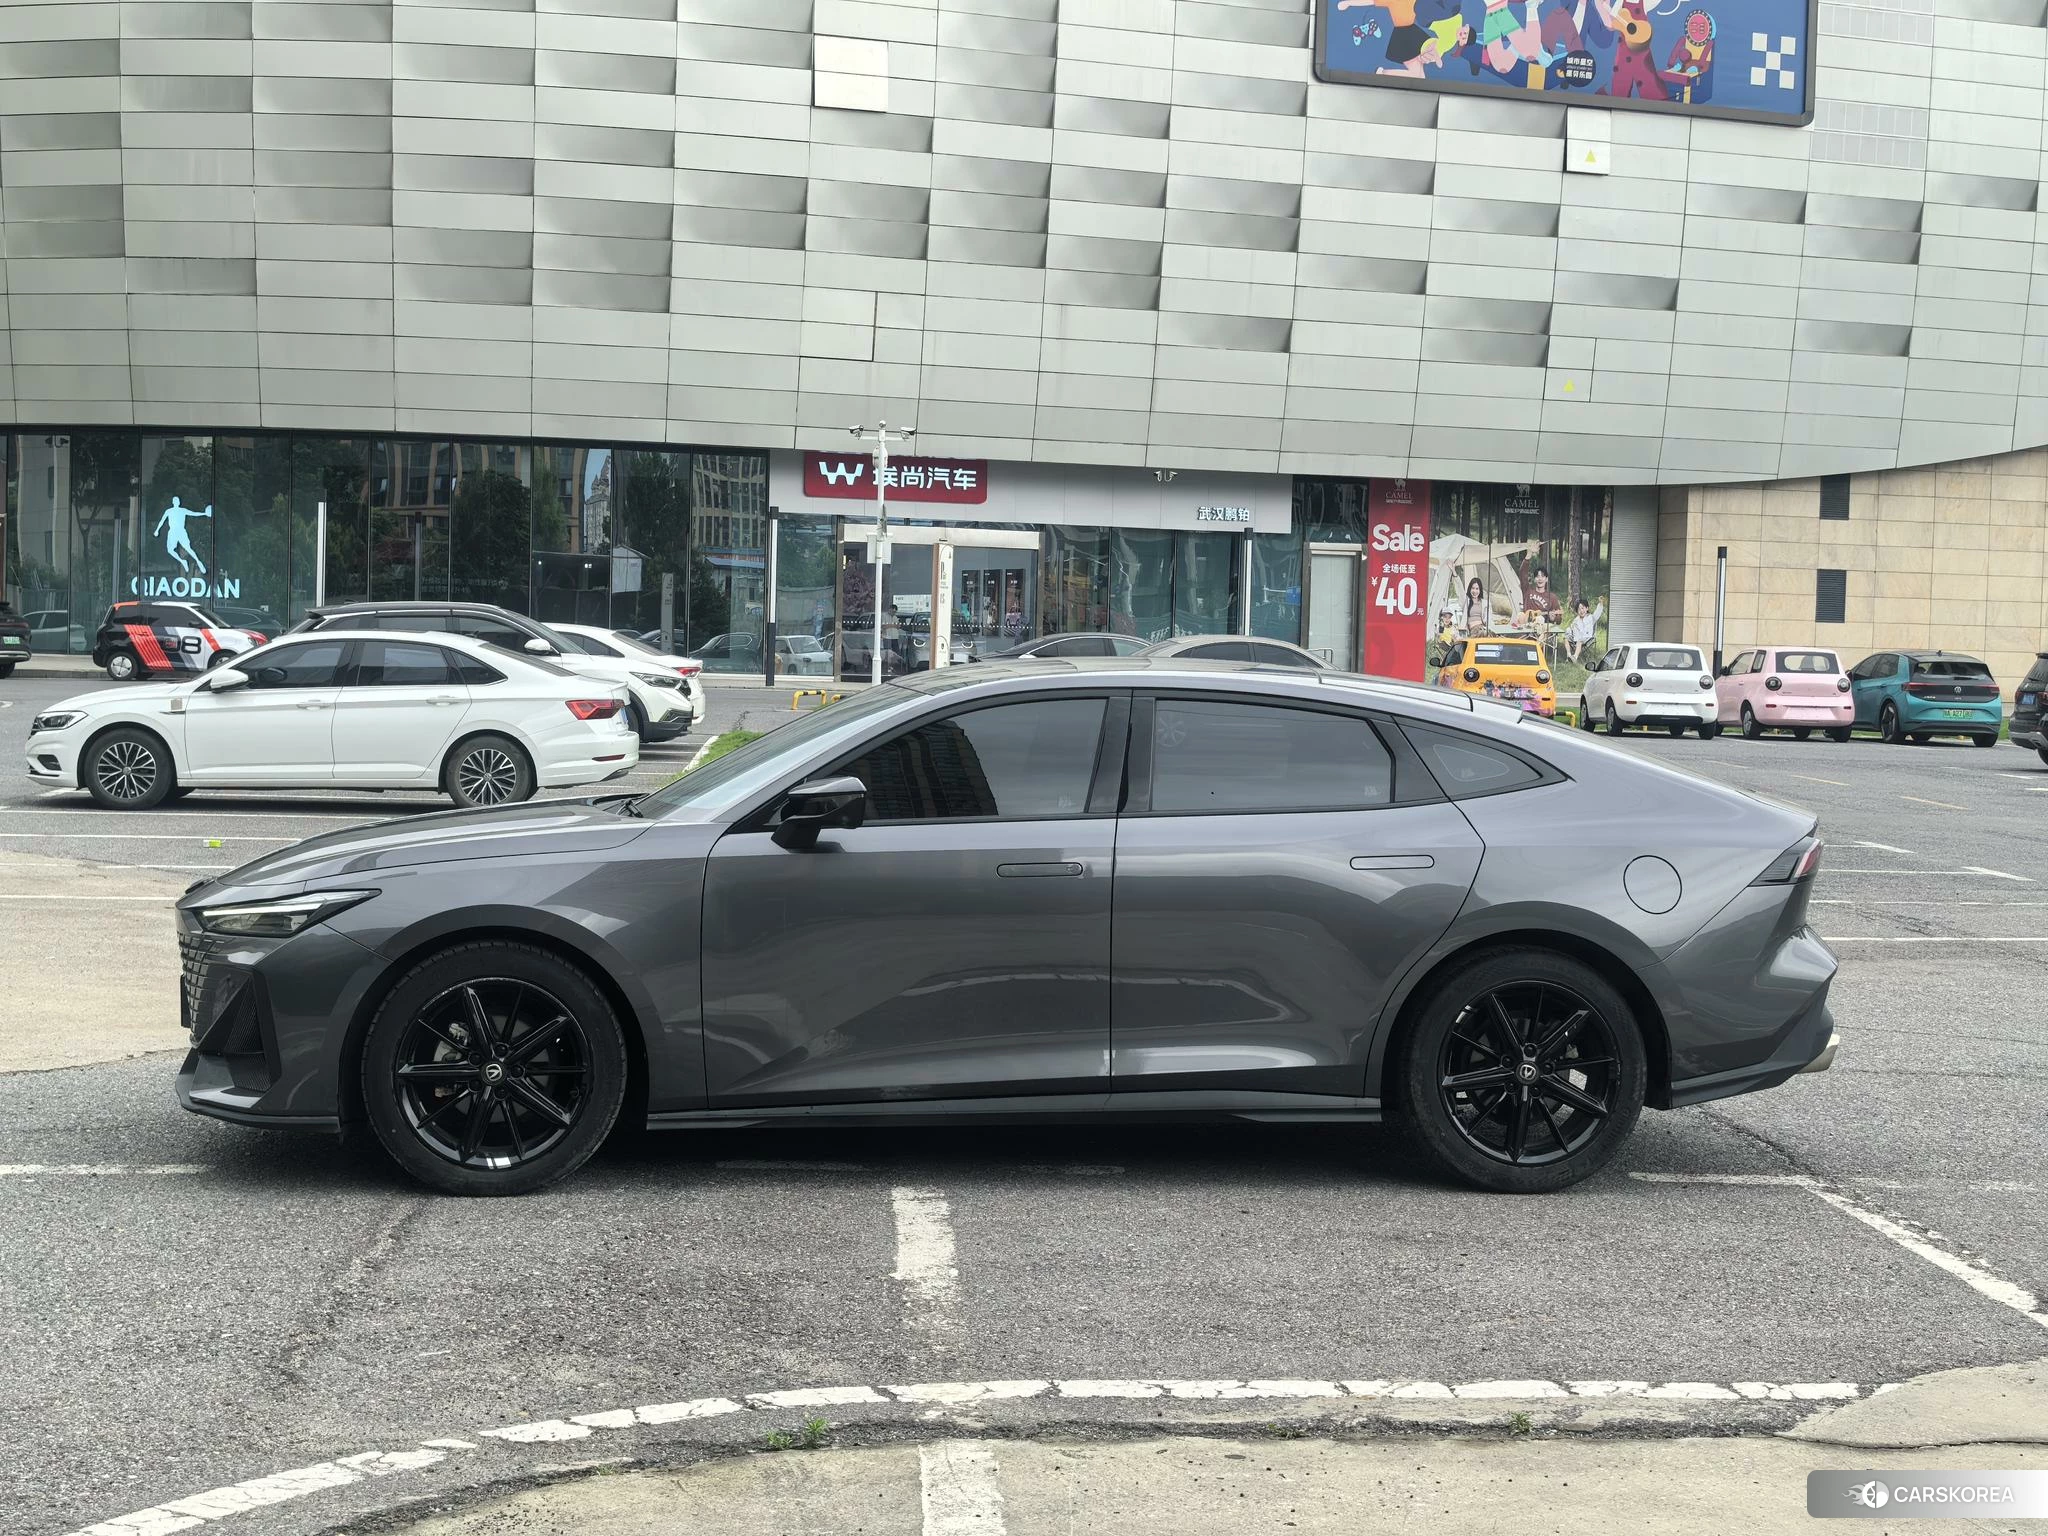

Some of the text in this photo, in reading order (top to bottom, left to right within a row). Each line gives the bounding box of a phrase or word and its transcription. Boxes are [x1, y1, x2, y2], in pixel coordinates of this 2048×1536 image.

[1385, 491, 1412, 500] CAMEL
[1505, 498, 1539, 508] CAMEL
[1372, 523, 1424, 552] Sale
[1382, 563, 1416, 573] 全场低至
[131, 576, 240, 599] QIAODAN
